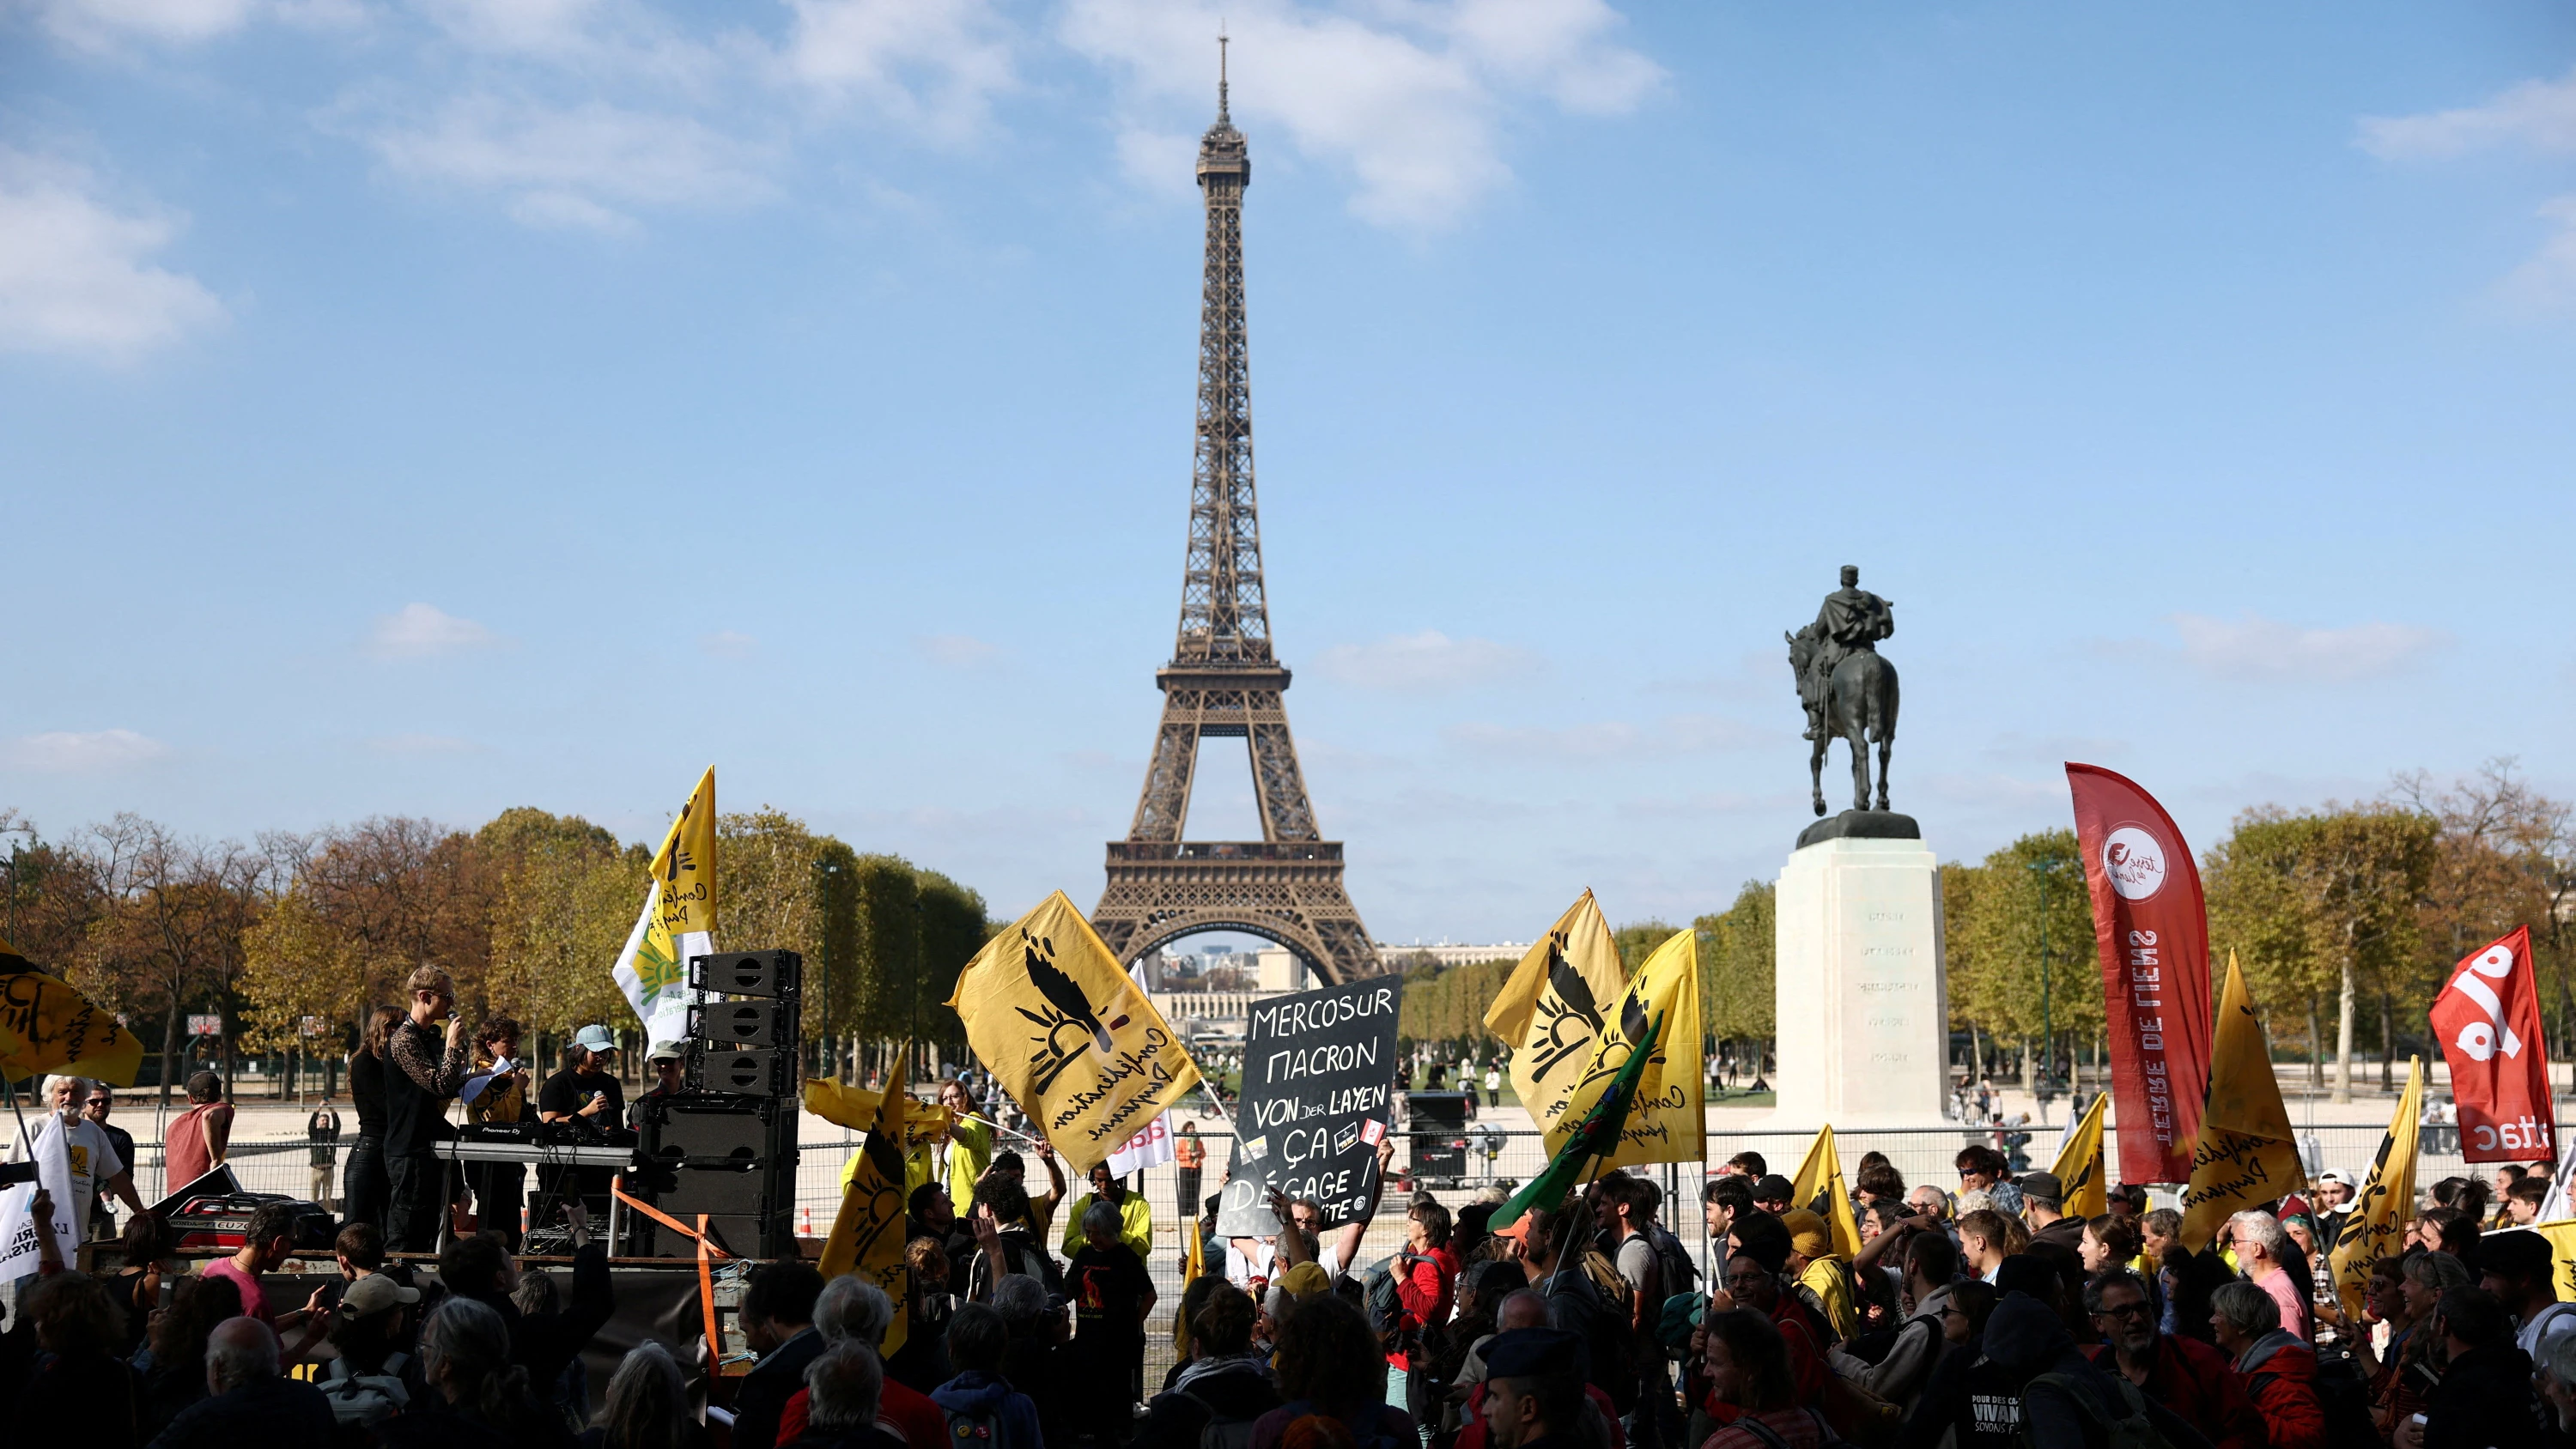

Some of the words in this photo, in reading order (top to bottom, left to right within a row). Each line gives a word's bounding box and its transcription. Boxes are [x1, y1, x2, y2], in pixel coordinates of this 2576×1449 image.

[1253, 988, 1393, 1040] MERCOSUR
[1267, 1035, 1377, 1084] MACRON
[1254, 1096, 1299, 1129] VON
[1300, 1104, 1327, 1119] DER
[1328, 1083, 1386, 1115] LAYEN
[1284, 1127, 1327, 1169] ÇA
[1972, 1395, 1990, 1404] POUR
[1992, 1396, 2006, 1404] DES
[2008, 1397, 2020, 1405] CA
[1972, 1404, 2020, 1423] VIVAN
[1975, 1422, 2006, 1434] SOYONS
